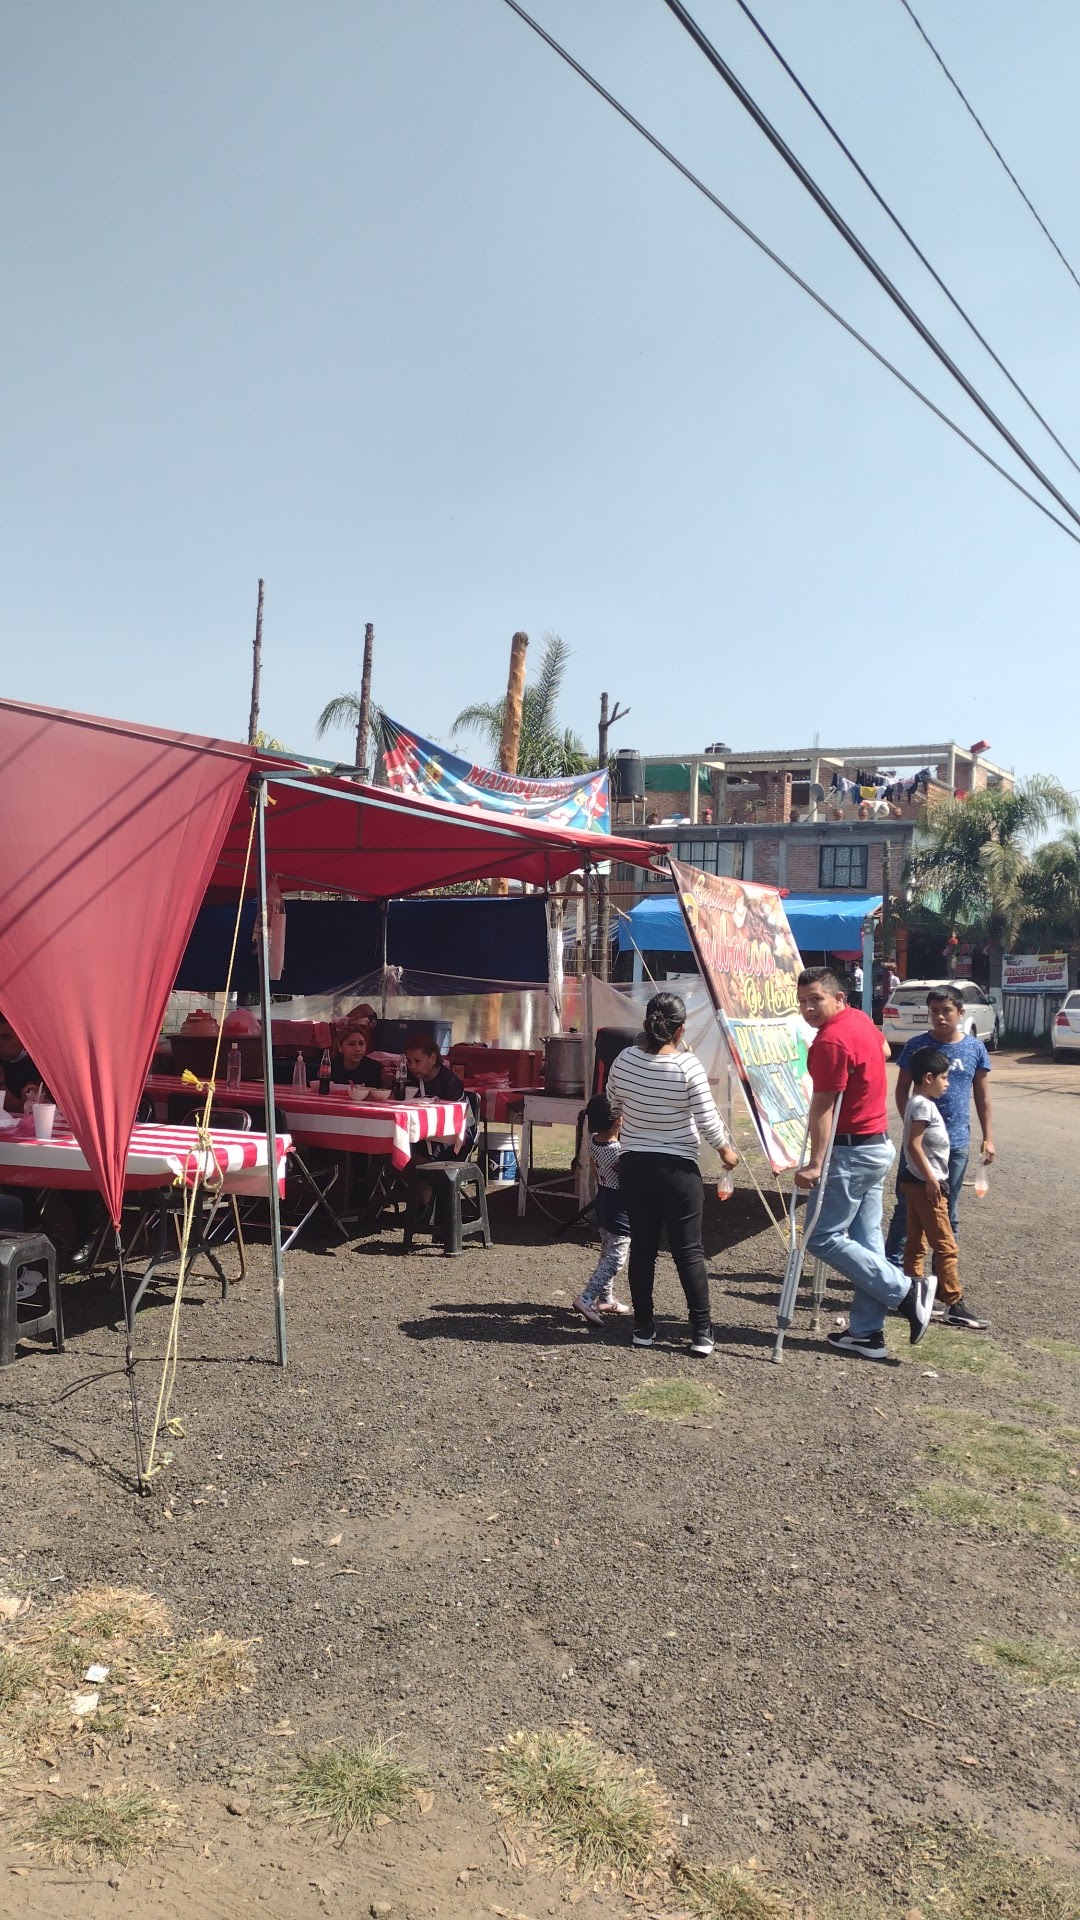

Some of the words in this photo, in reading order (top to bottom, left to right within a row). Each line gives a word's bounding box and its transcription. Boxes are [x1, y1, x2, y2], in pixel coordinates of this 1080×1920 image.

[1004, 963, 1065, 976] MICHELADAS
[744, 976, 764, 1014] De
[735, 1023, 800, 1067] PULQUE
[770, 1071, 795, 1110] Y
